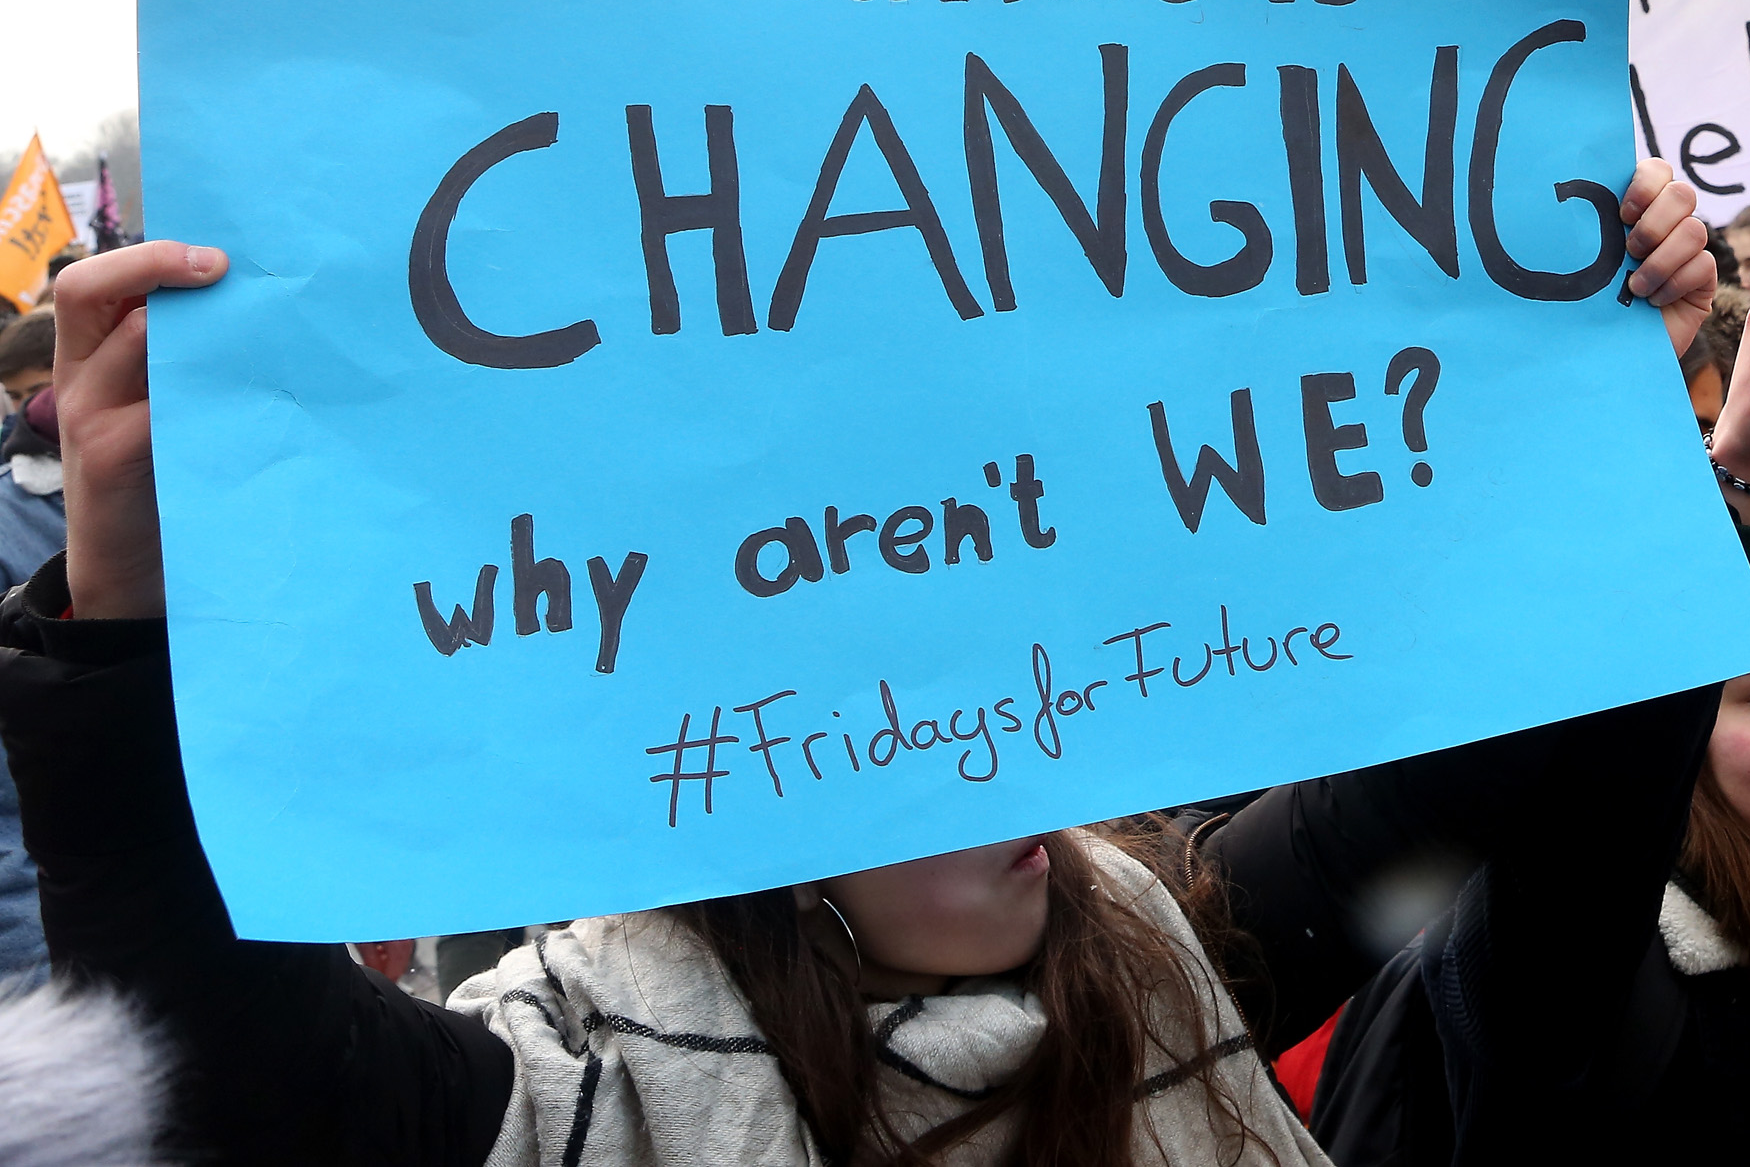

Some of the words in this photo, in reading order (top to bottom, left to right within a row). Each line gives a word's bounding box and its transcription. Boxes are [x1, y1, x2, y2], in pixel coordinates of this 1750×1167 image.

[413, 513, 649, 674] why
[734, 453, 1057, 598] aren't
[1146, 346, 1441, 536] WE?
